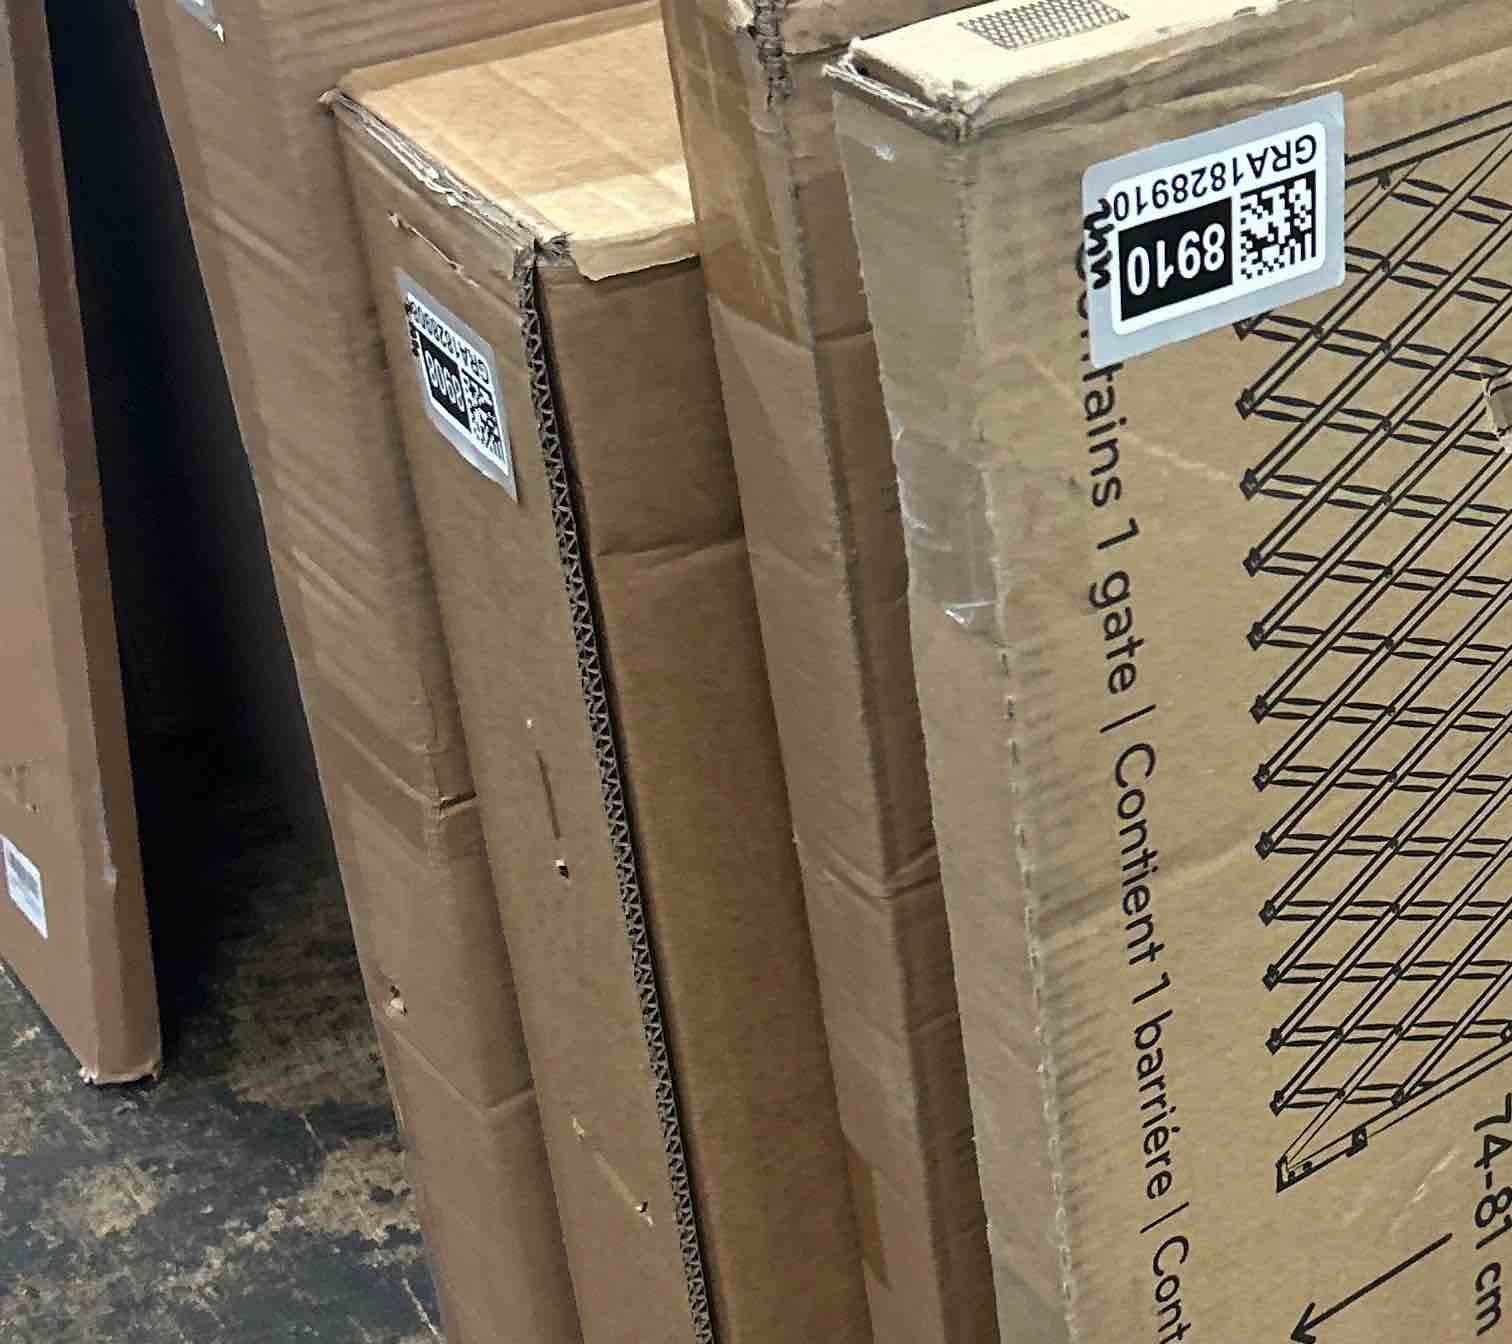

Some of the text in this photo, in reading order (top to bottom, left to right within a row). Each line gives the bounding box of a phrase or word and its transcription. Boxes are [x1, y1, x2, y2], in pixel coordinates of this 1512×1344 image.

[1112, 133, 1319, 222] GRA1828910
[1126, 222, 1226, 297] 8910
[1096, 516, 1140, 551] 1
[1088, 569, 1146, 695] gate
[1114, 742, 1166, 966] Contient
[1131, 971, 1172, 1005] 1
[1133, 1009, 1181, 1201] barrière
[1474, 1261, 1503, 1337] cm
